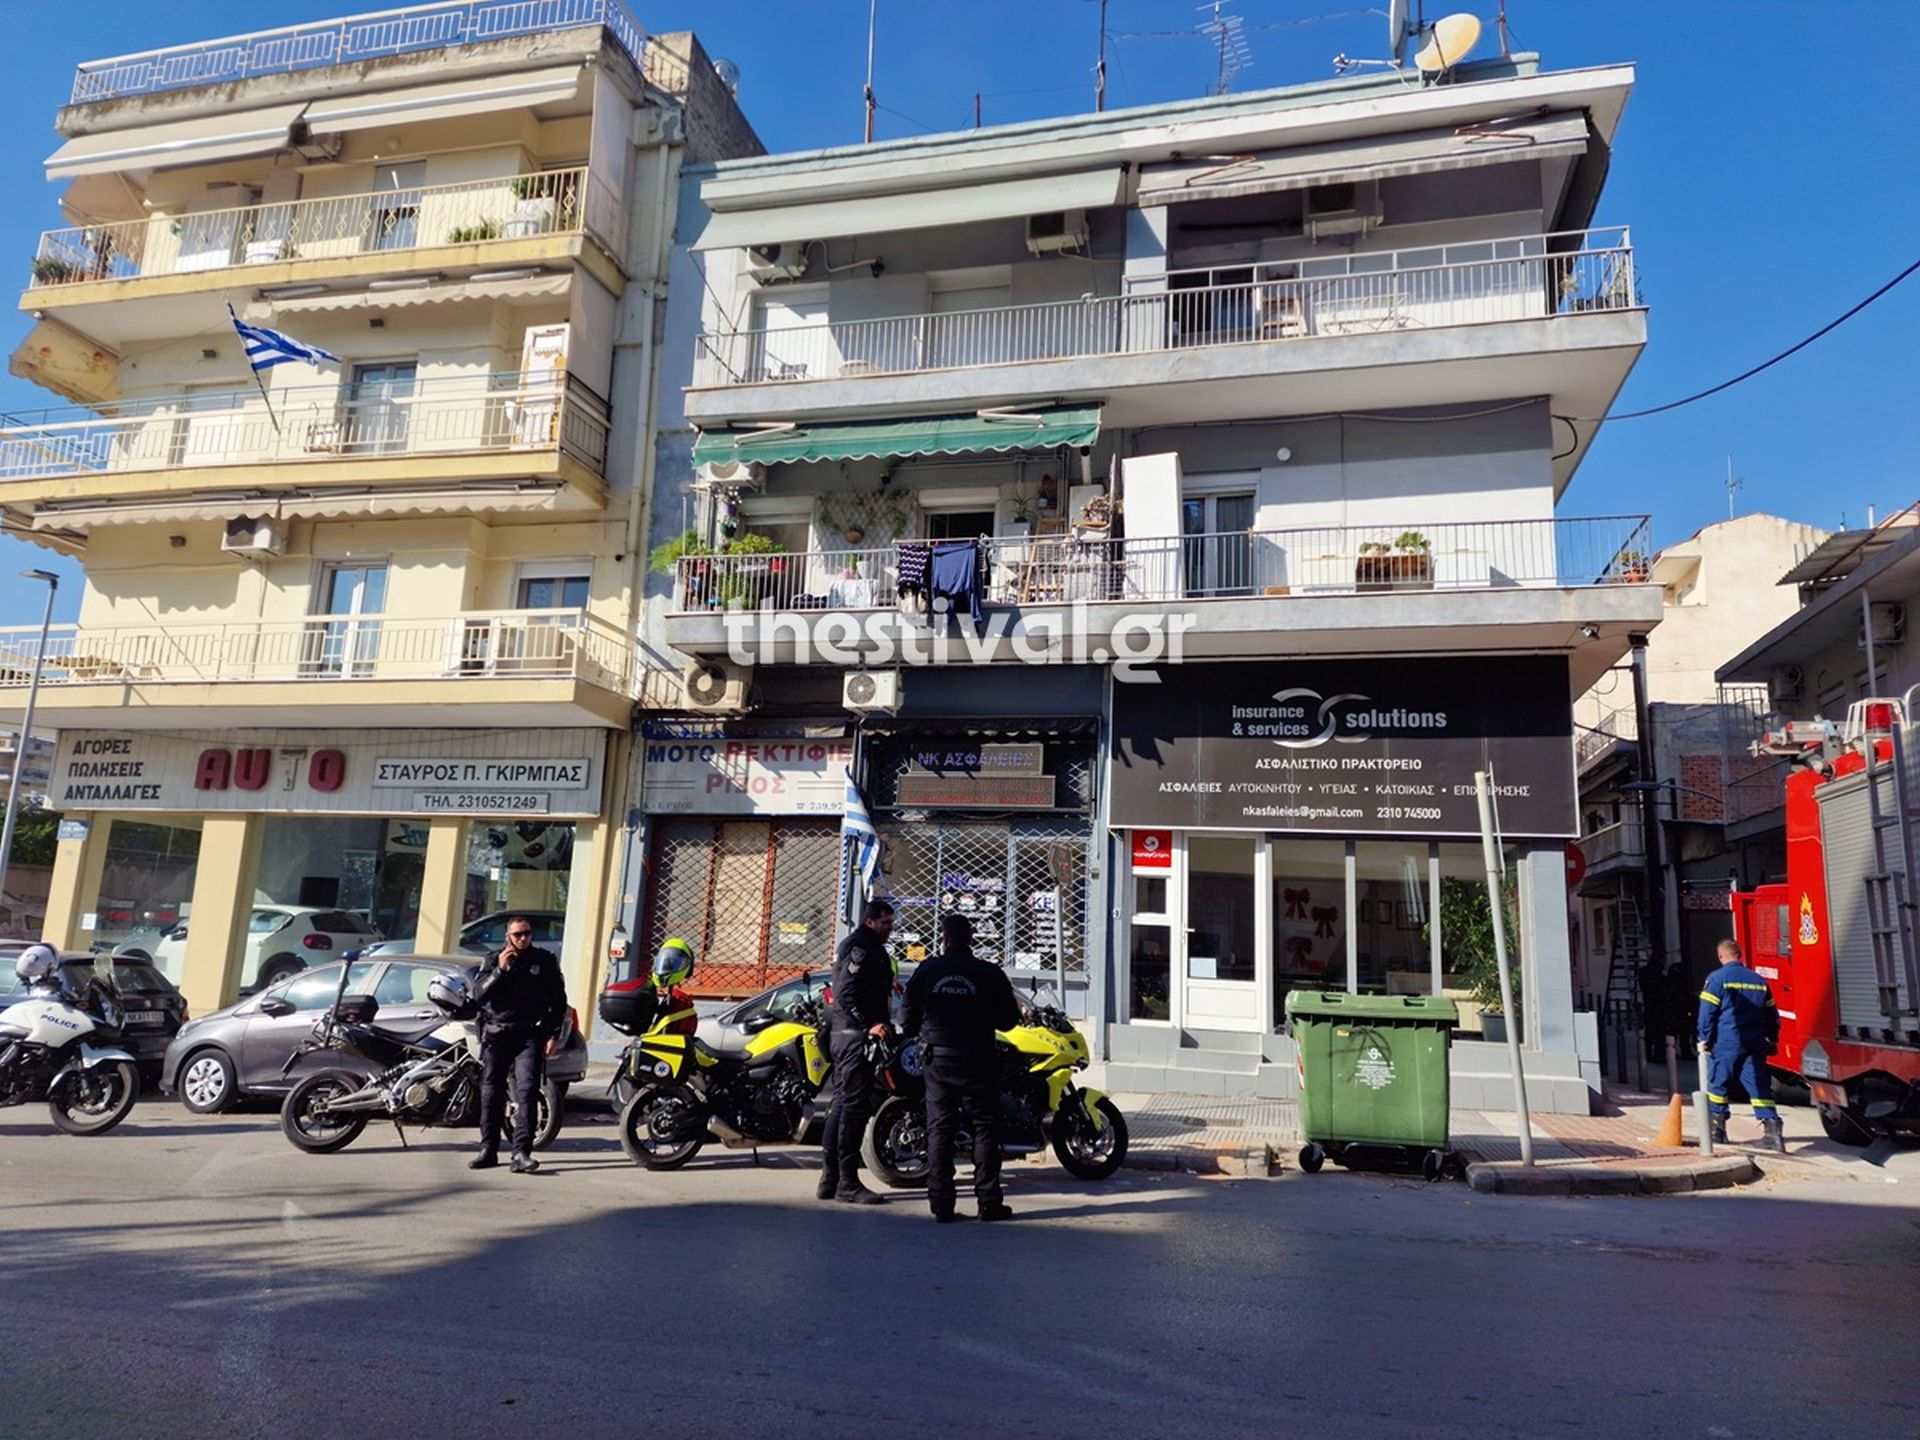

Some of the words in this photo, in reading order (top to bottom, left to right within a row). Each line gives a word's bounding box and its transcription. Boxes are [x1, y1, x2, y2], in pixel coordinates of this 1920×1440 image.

[1232, 705, 1304, 719] insurance
[1346, 709, 1447, 728] solutions
[1232, 722, 1244, 736] &
[1248, 722, 1309, 736] services
[73, 739, 132, 755] ΑΓΟΡΕΣ
[68, 762, 144, 777] ΠΩΛΗΣΕΙΣ
[195, 748, 346, 792] AUTO
[1255, 758, 1338, 770] ΑΣΦΑΛΙΣΤΙΚΟ
[1342, 759, 1422, 770] ΠΡΑΚΤΟΡΕΙΟ
[379, 764, 459, 781] ΣΤΑΥΡΟΣ
[463, 765, 480, 781] Π.
[485, 765, 582, 782] ΓΚΙΡΜΠΑΣ
[706, 774, 785, 794] ΡΙΖΟΣ
[1159, 782, 1222, 793] ΑΣΦΑΛΕΙΕΣ
[1228, 783, 1302, 794] ΑΥΤΟΚΙΝΗΤΟΥ
[1319, 784, 1357, 794] ΥΓΕΙΑΣ
[1376, 785, 1434, 795] ΚΑΤΟΙΚΙΑΣ
[1454, 785, 1530, 796] ΕΠΙΧΙΡΗΣΗΣ
[64, 784, 161, 800] ΑΝΤΑΛΛΑΓΕΣ
[424, 795, 453, 808] ΤΗΛ.
[458, 795, 537, 808] 2310521249
[1243, 805, 1363, 819] nkasfaleies@gmail.com
[1377, 808, 1402, 818] 2310
[1404, 808, 1441, 819] 745000
[941, 986, 968, 995] POLICE
[40, 1014, 80, 1031] POLICE
